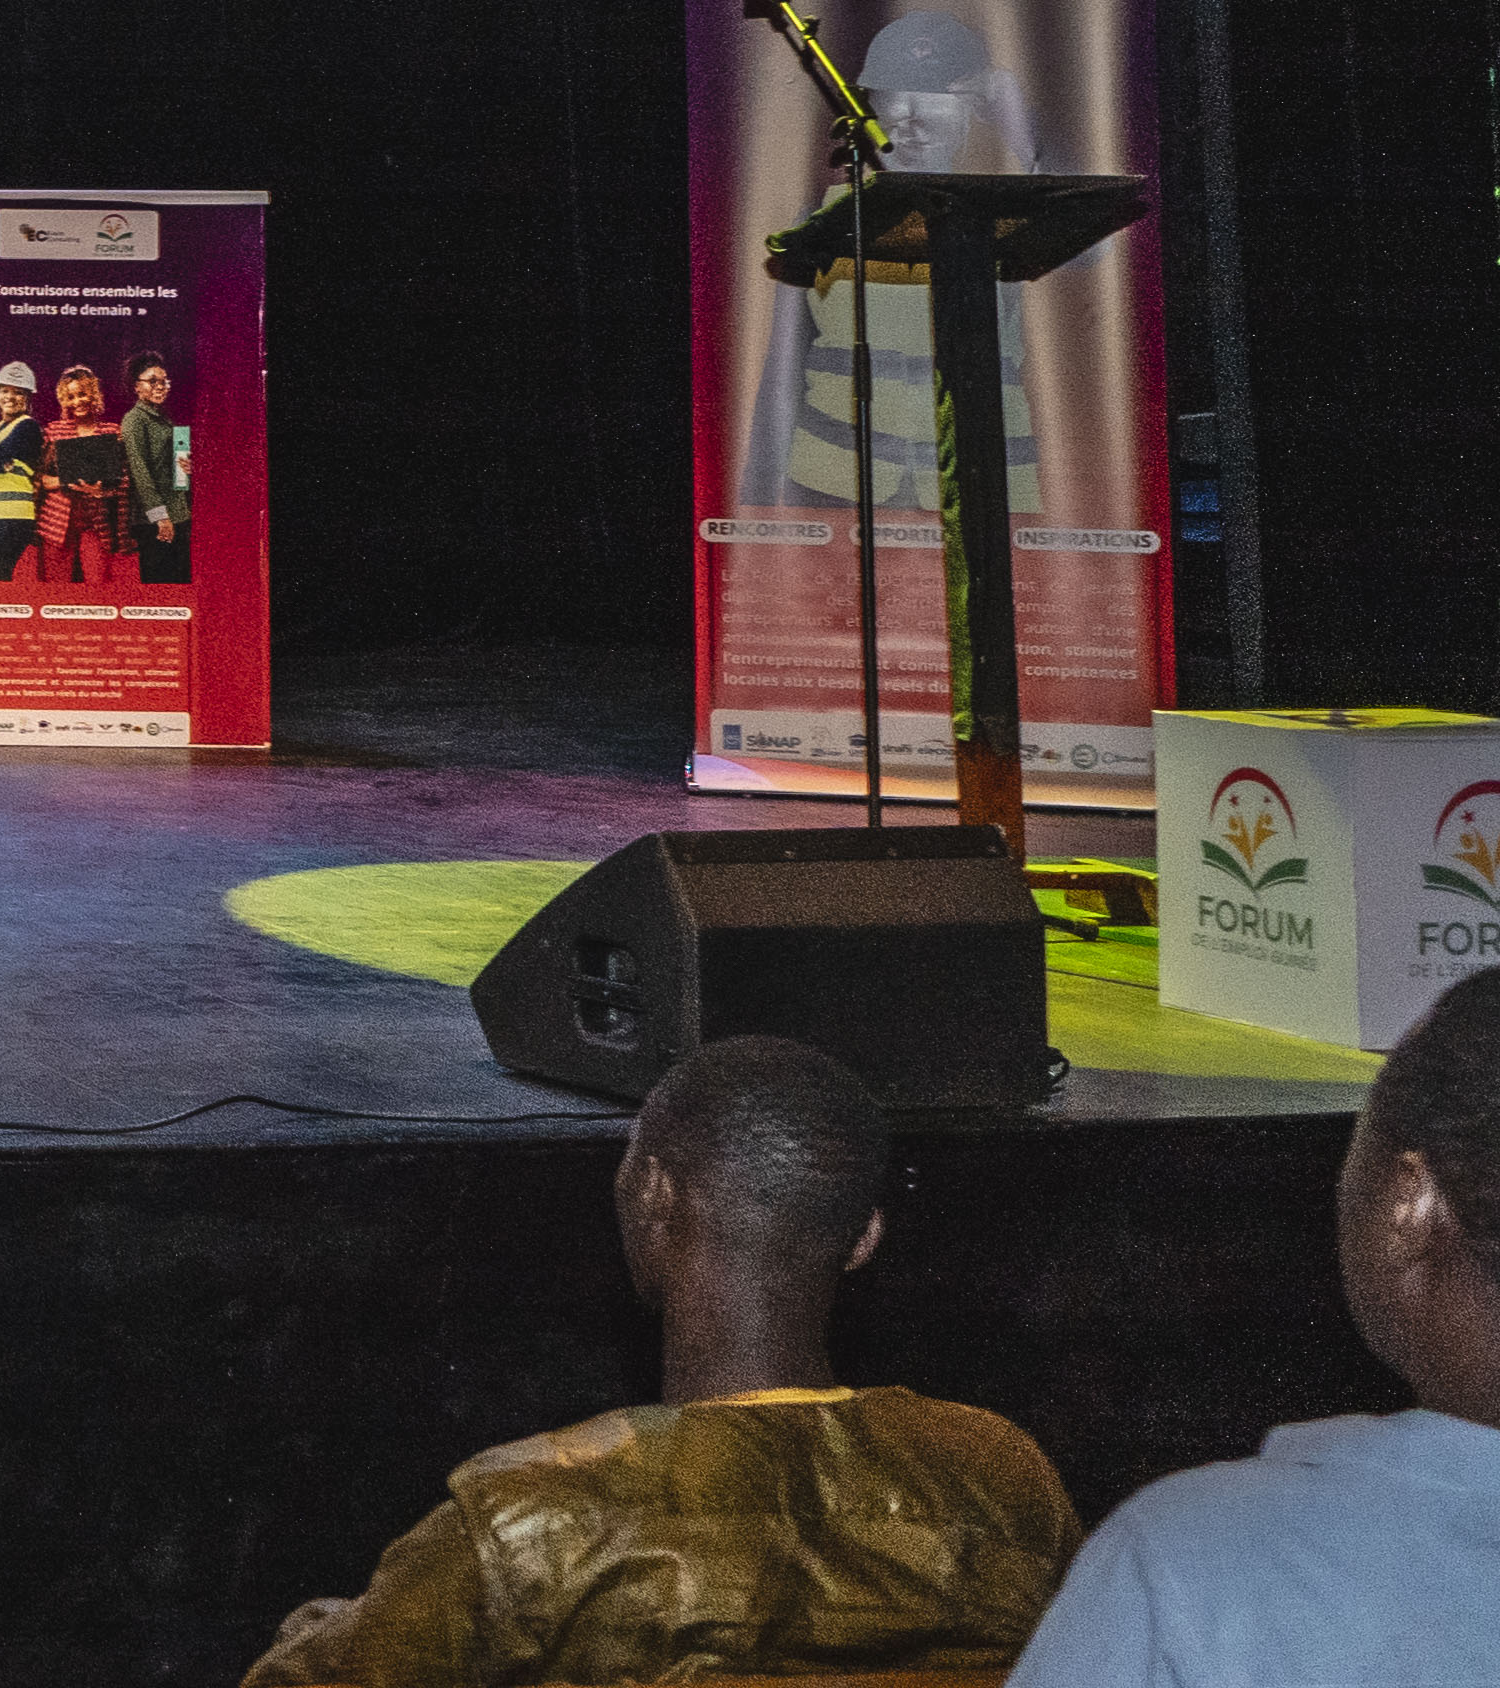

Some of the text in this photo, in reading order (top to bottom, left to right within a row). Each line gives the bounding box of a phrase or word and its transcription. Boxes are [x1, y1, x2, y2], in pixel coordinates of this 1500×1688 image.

[27, 230, 48, 242] EC
[95, 243, 134, 253] FORUM
[82, 285, 155, 298] ensembles
[157, 286, 178, 298] les
[9, 303, 58, 315] talents
[60, 303, 77, 315] de
[80, 303, 132, 316] demain
[707, 521, 828, 540] RENCONTRES
[123, 608, 188, 617] INSPIRATIONS
[898, 658, 949, 673] conne
[722, 672, 780, 687] locales
[783, 674, 815, 688] aux
[817, 673, 863, 689] besoi
[1198, 895, 1314, 950] FORUM
[1418, 922, 1500, 957] FOR
